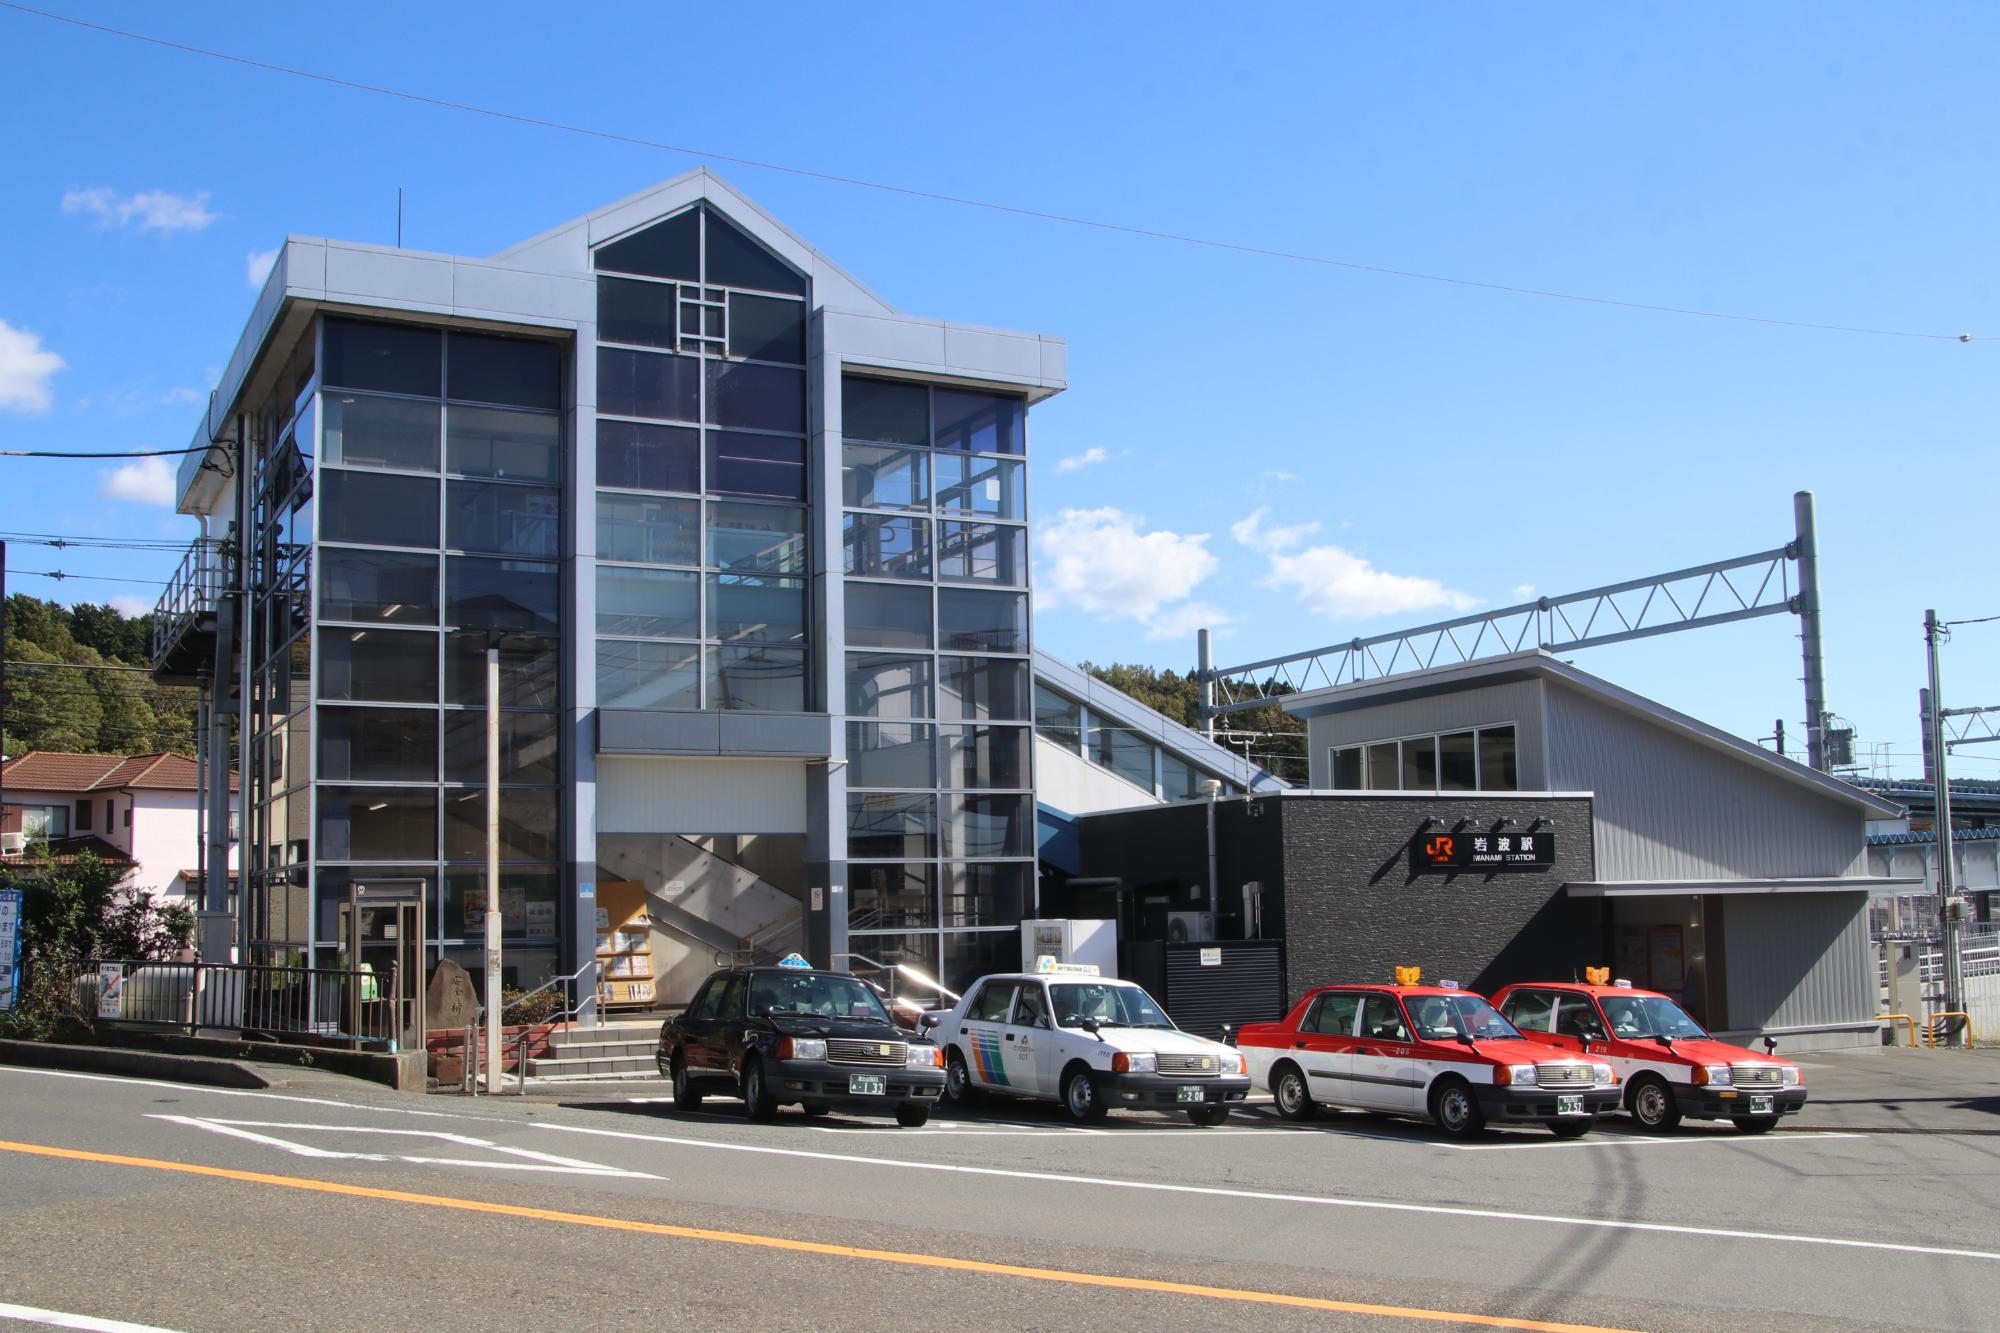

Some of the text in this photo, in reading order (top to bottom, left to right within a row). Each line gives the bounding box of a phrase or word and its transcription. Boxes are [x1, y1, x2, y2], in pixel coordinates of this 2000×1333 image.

[1426, 837, 1454, 855] JR
[1474, 837, 1534, 852] 岩波駅
[1473, 854, 1502, 862] IWANAMI
